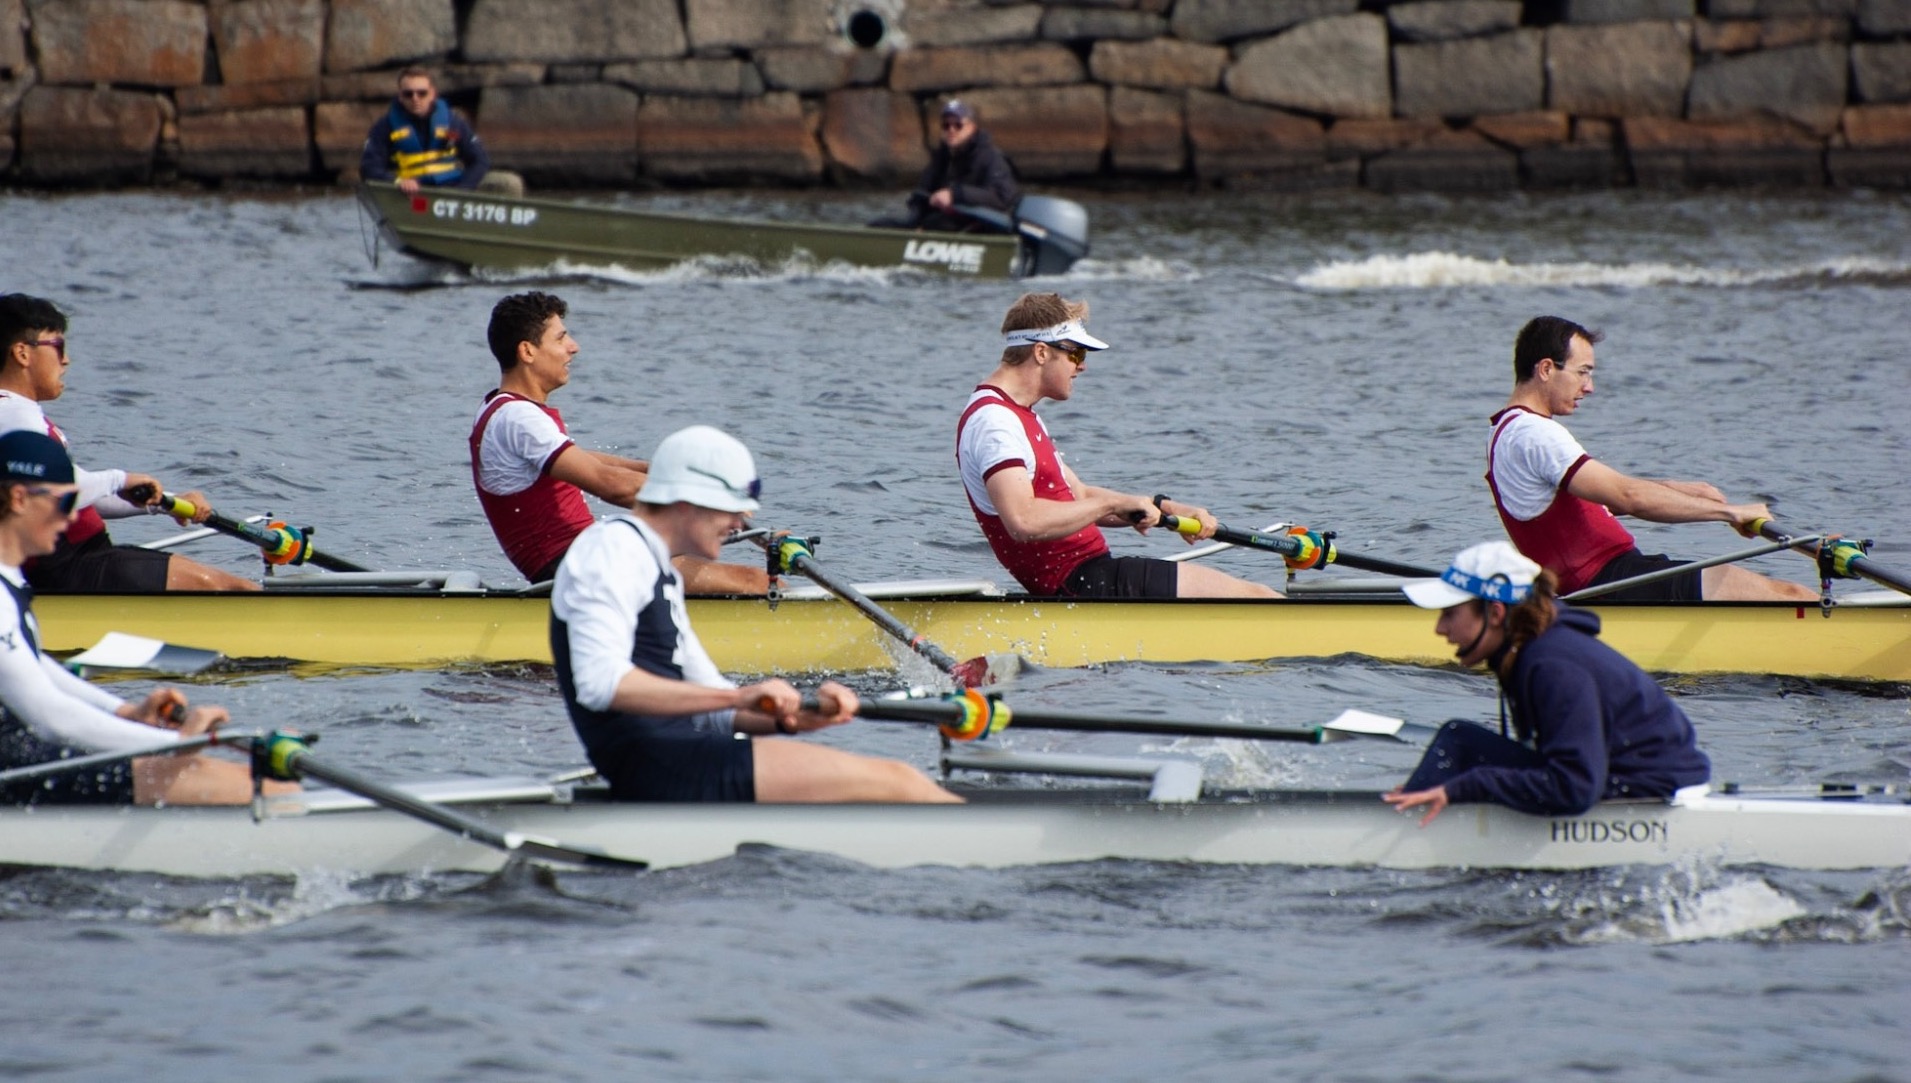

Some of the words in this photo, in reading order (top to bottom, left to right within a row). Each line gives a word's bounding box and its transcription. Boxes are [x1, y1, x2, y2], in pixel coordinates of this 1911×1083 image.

[433, 199, 459, 218] CT
[462, 202, 506, 222] 3176
[511, 207, 537, 225] BP
[904, 240, 986, 264] LOWE
[7, 461, 45, 476] YALE
[1551, 821, 1667, 842] HUDSON
